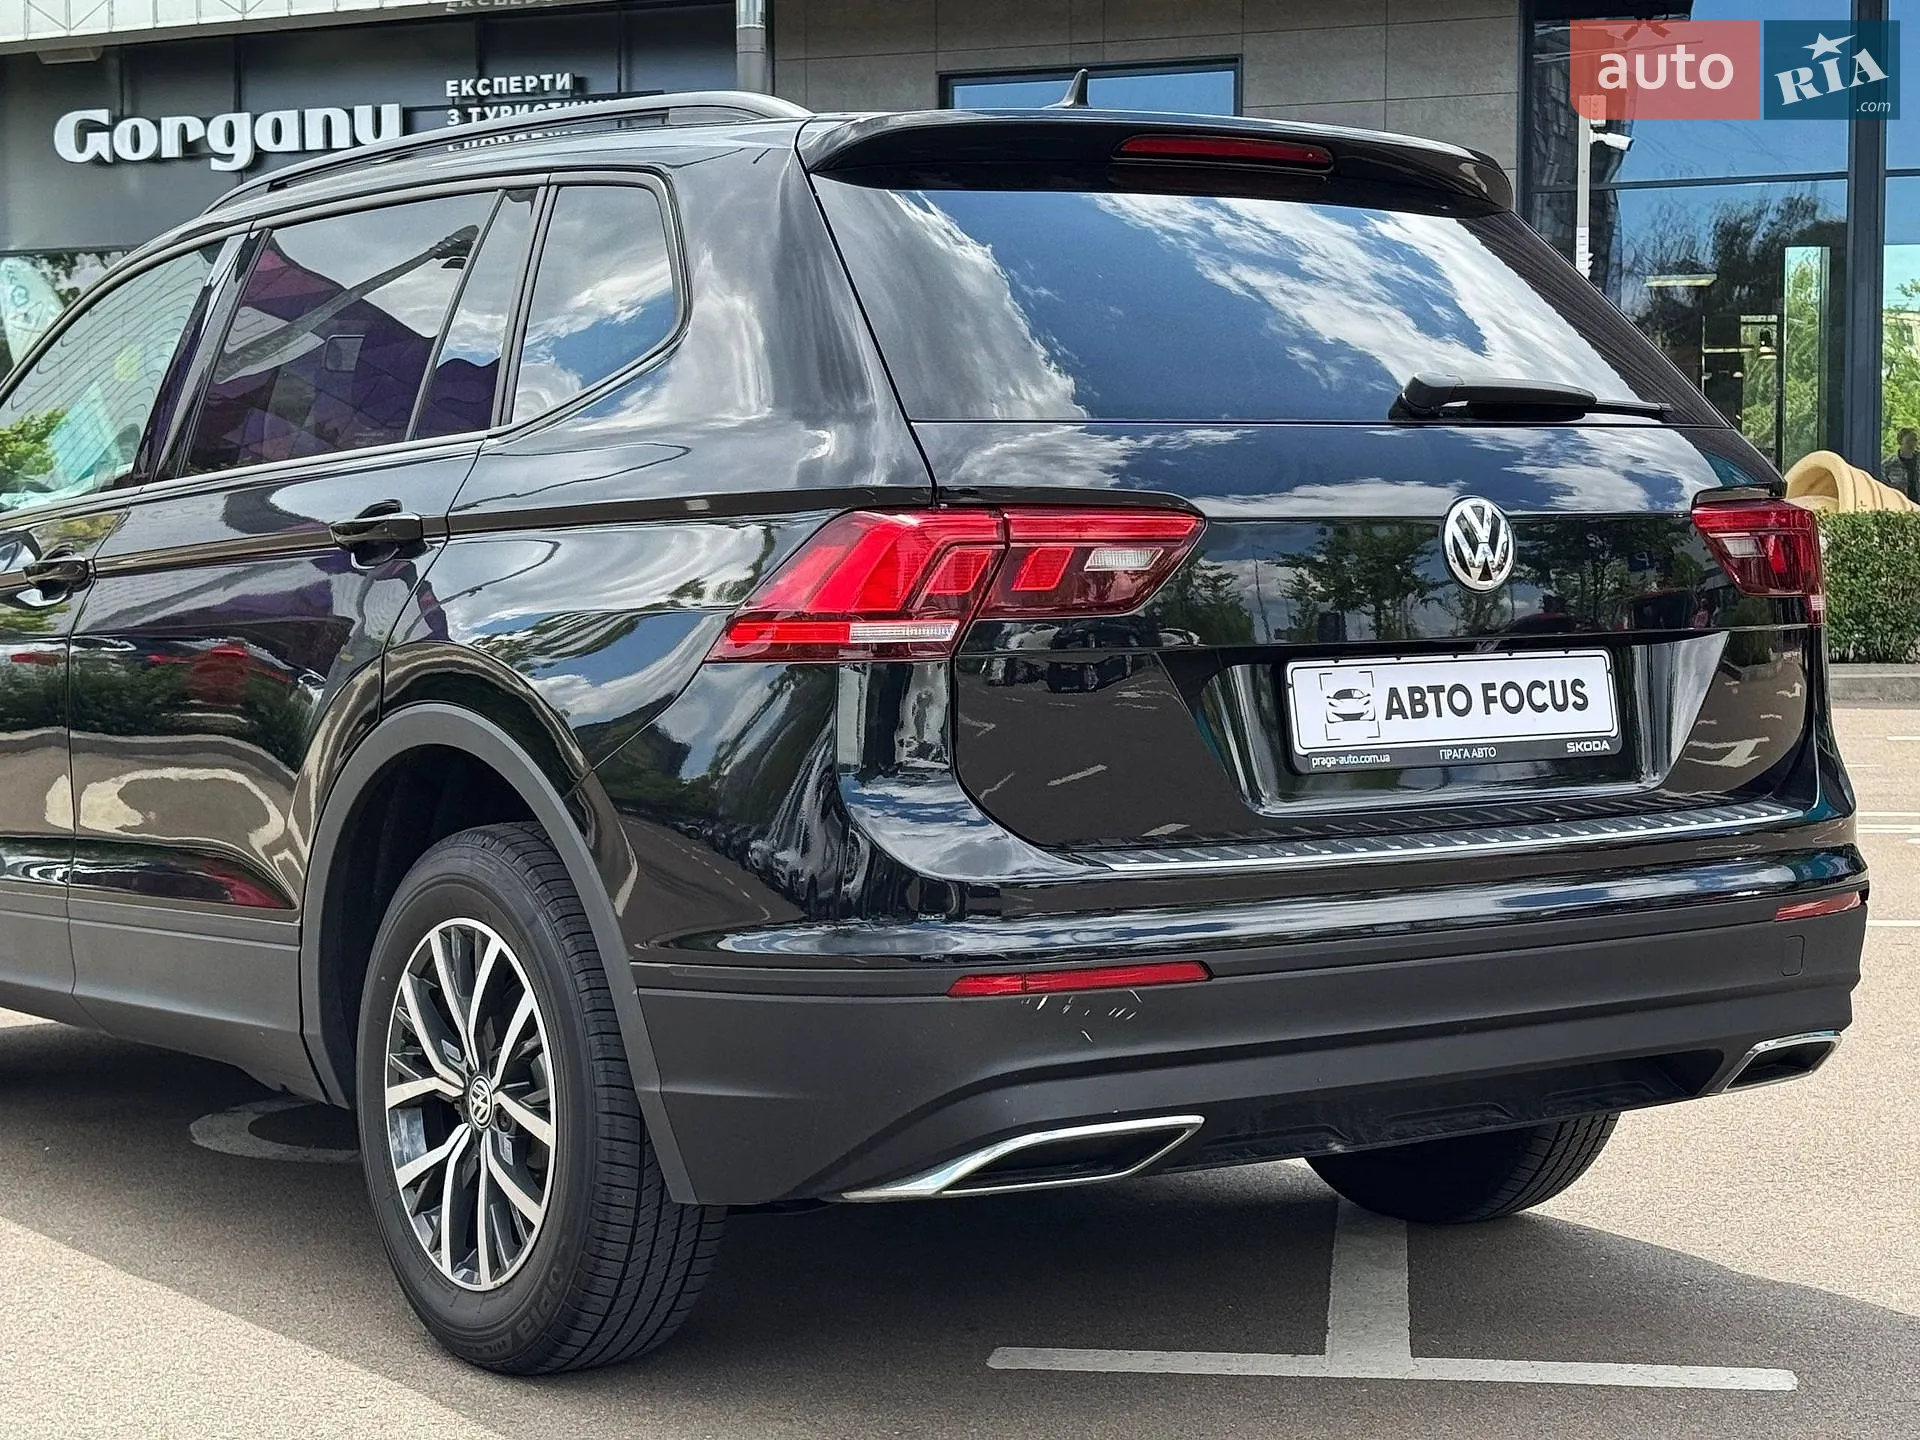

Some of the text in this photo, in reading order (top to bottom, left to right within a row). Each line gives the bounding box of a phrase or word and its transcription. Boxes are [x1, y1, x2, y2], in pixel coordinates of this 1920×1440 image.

[446, 73, 572, 97] ЕКСПЕРТИ
[1385, 678, 1589, 720] АВТО FOCUS
[1311, 753, 1391, 768] praga-auto.com.ua
[1439, 746, 1497, 760] ПРАГА АВТО
